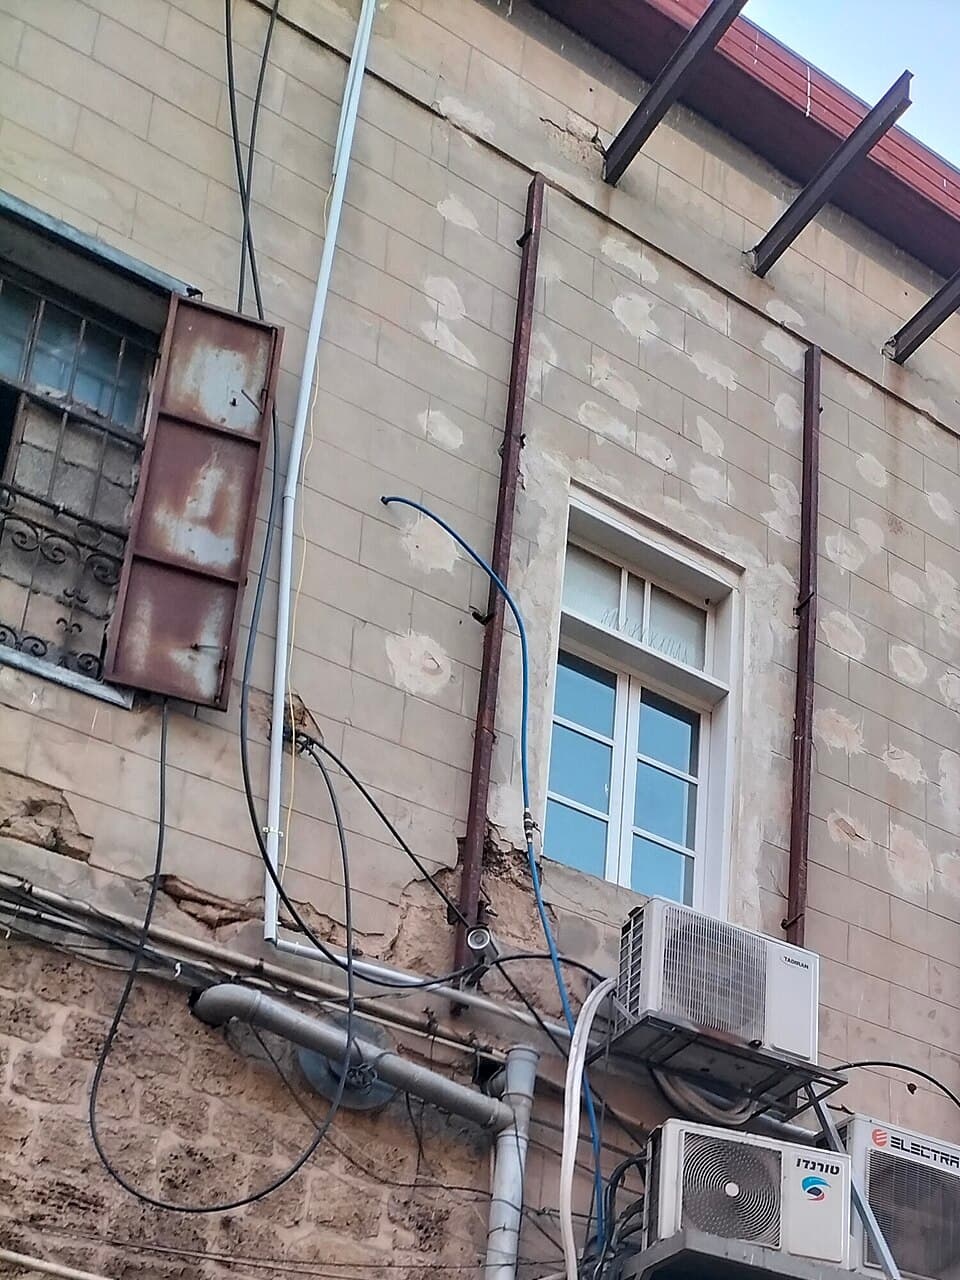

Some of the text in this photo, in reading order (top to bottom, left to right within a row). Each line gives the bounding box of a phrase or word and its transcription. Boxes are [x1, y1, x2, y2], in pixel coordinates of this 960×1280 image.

[783, 955, 809, 969] TADIRAN
[890, 1135, 960, 1169] ELECTRA
[796, 1157, 840, 1175] טורנדו
